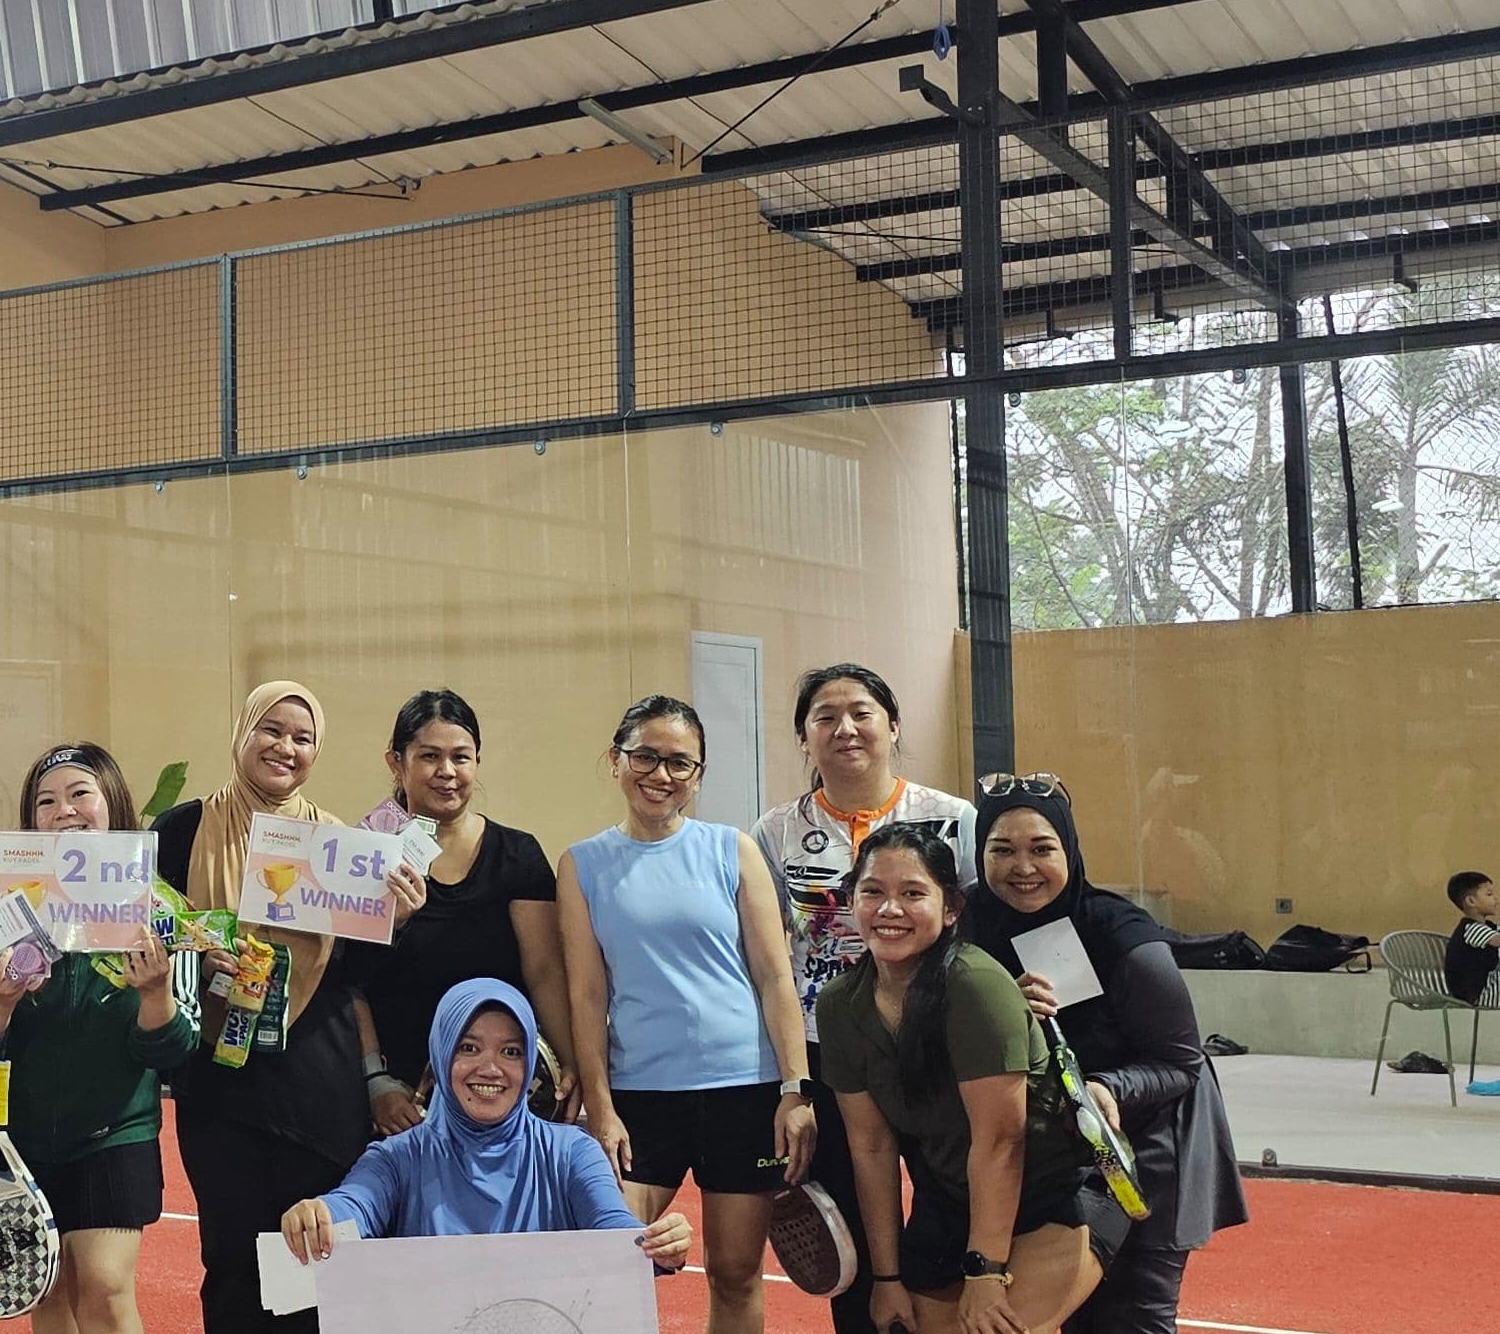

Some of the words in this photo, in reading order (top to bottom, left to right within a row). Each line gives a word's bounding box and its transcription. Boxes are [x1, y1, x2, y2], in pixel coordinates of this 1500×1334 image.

[61, 849, 87, 883] 2
[100, 849, 149, 883] nd
[322, 838, 338, 873] 1
[348, 849, 386, 881] st
[48, 901, 149, 924] WINNER
[300, 887, 387, 918] WINNER
